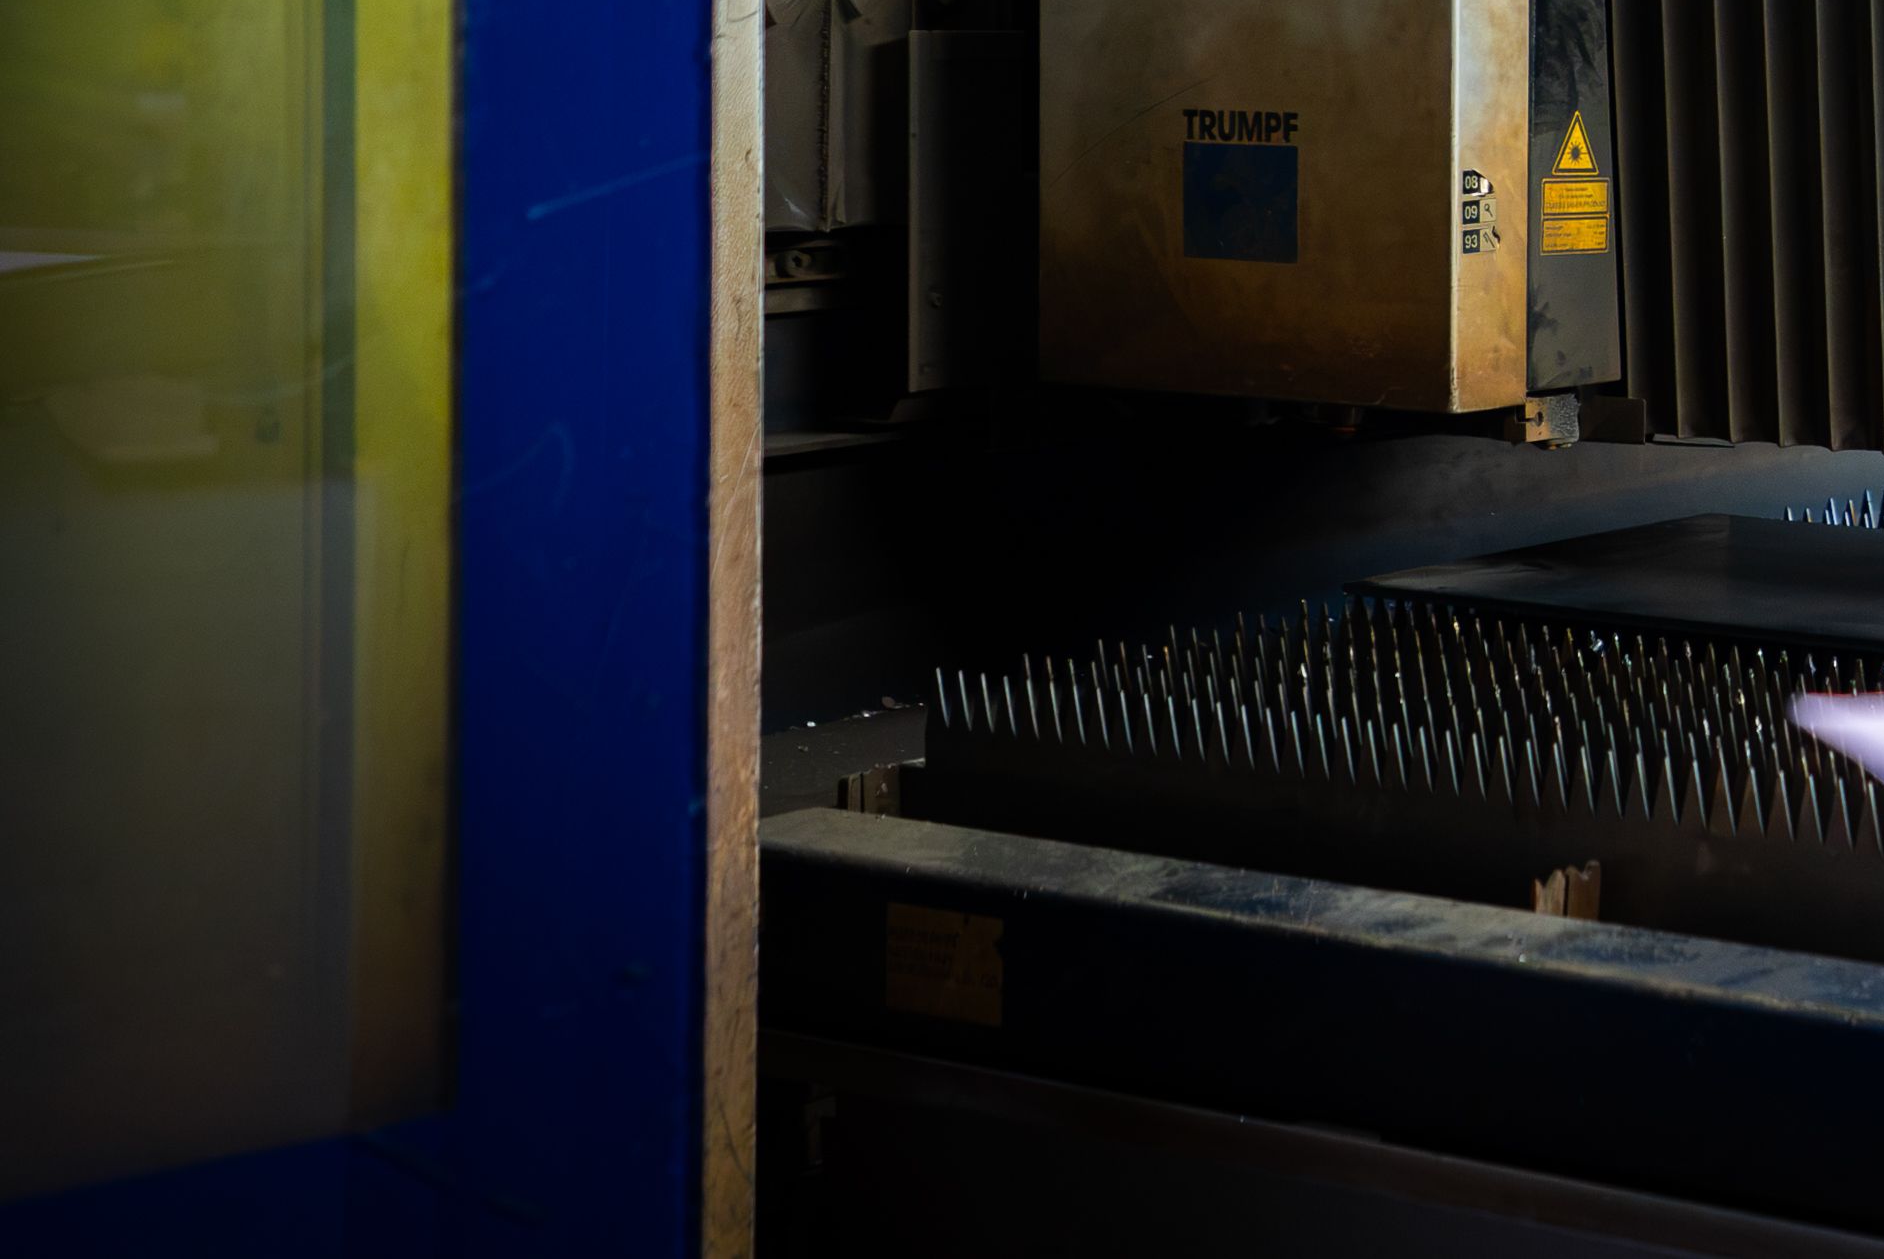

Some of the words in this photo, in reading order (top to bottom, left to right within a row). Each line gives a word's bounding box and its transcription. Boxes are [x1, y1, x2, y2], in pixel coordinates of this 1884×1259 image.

[1182, 108, 1299, 143] TRUMPF
[1464, 175, 1479, 189] 08
[1464, 205, 1478, 219] 09
[1464, 234, 1478, 249] 93
